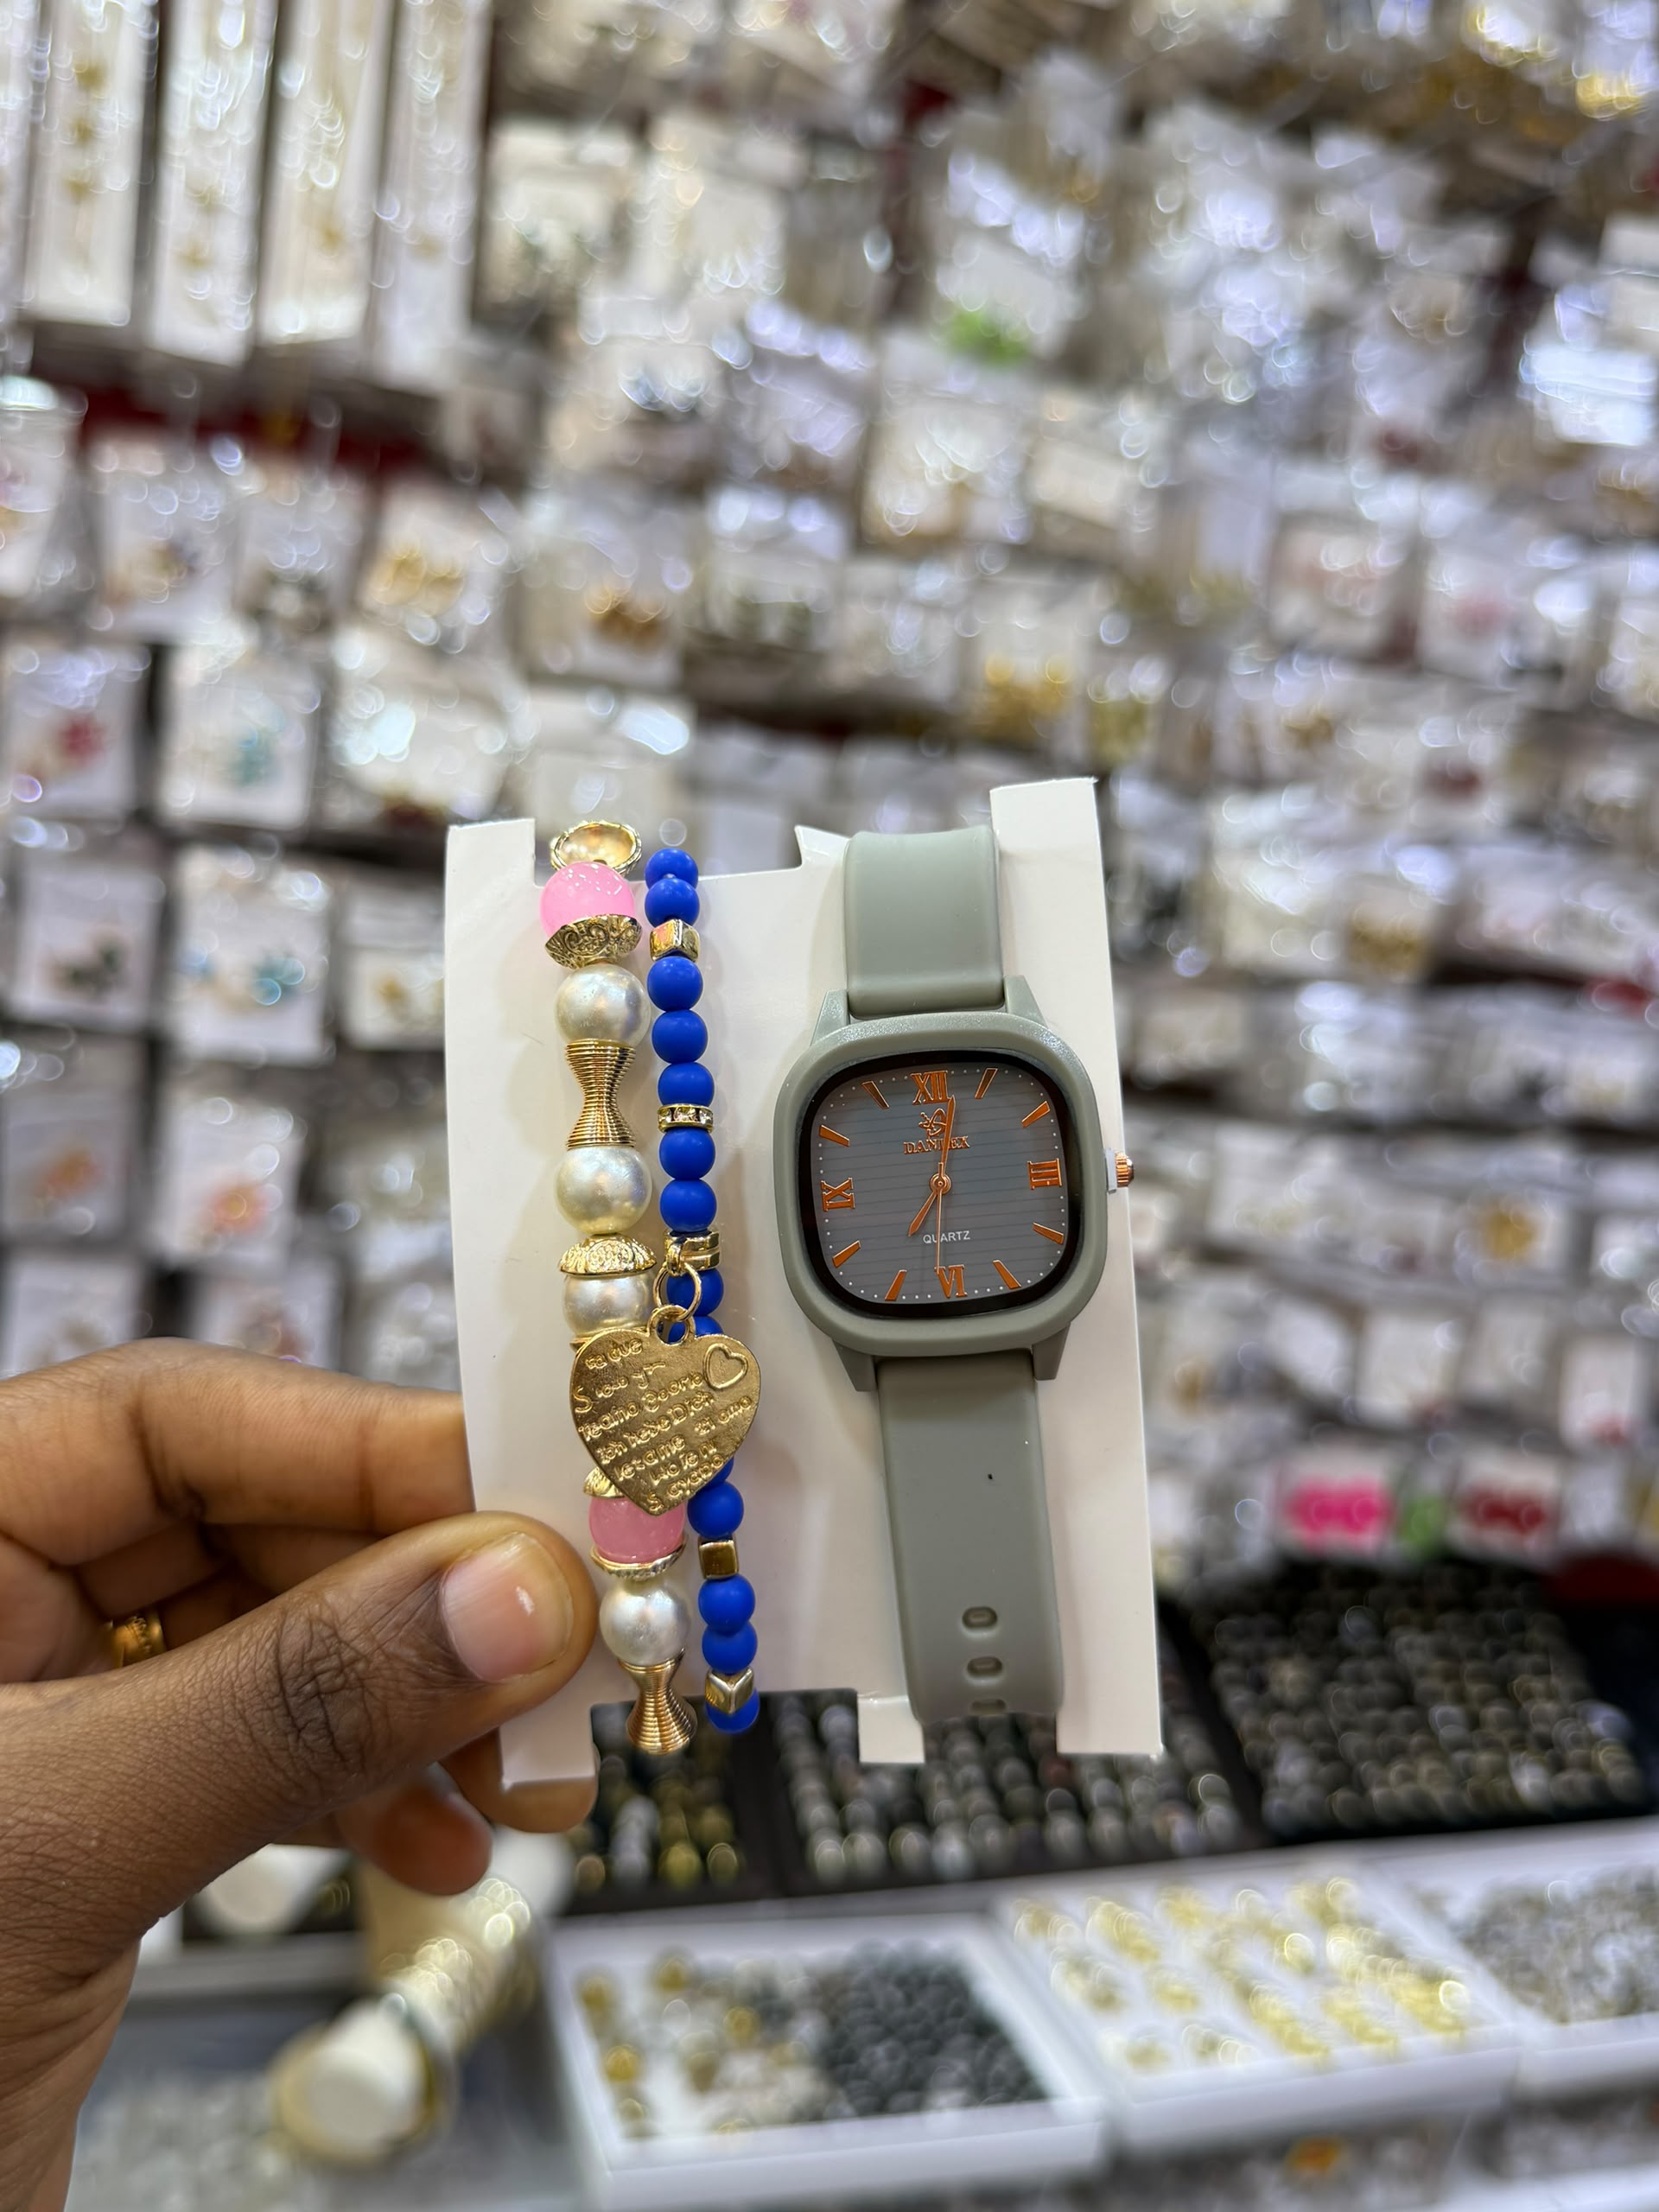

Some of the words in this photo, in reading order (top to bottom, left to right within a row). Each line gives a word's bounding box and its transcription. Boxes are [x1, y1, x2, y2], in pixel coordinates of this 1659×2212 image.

[911, 1071, 949, 1105] XII
[821, 1177, 855, 1211] IX
[923, 1230, 970, 1244] QUARTZ
[935, 1264, 967, 1298] VI
